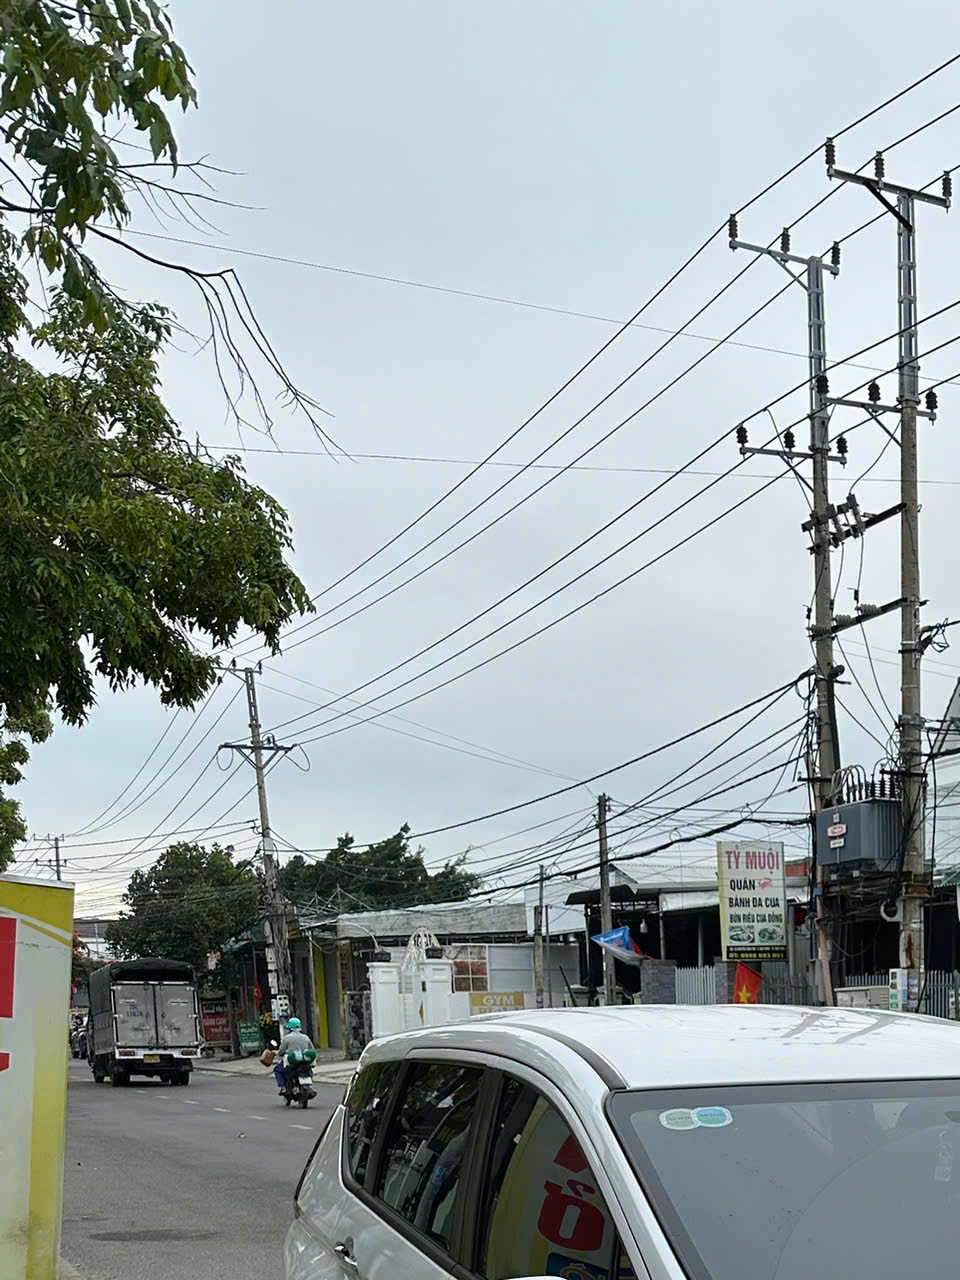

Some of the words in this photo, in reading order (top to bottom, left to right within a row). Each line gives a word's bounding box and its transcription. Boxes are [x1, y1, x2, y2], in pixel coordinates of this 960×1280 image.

[745, 847, 780, 875] MUỘI
[729, 878, 756, 892] QUÁN
[728, 895, 751, 908] BÁNH
[764, 897, 780, 908] CUA
[756, 913, 767, 923] CUA
[482, 995, 514, 1006] GYM
